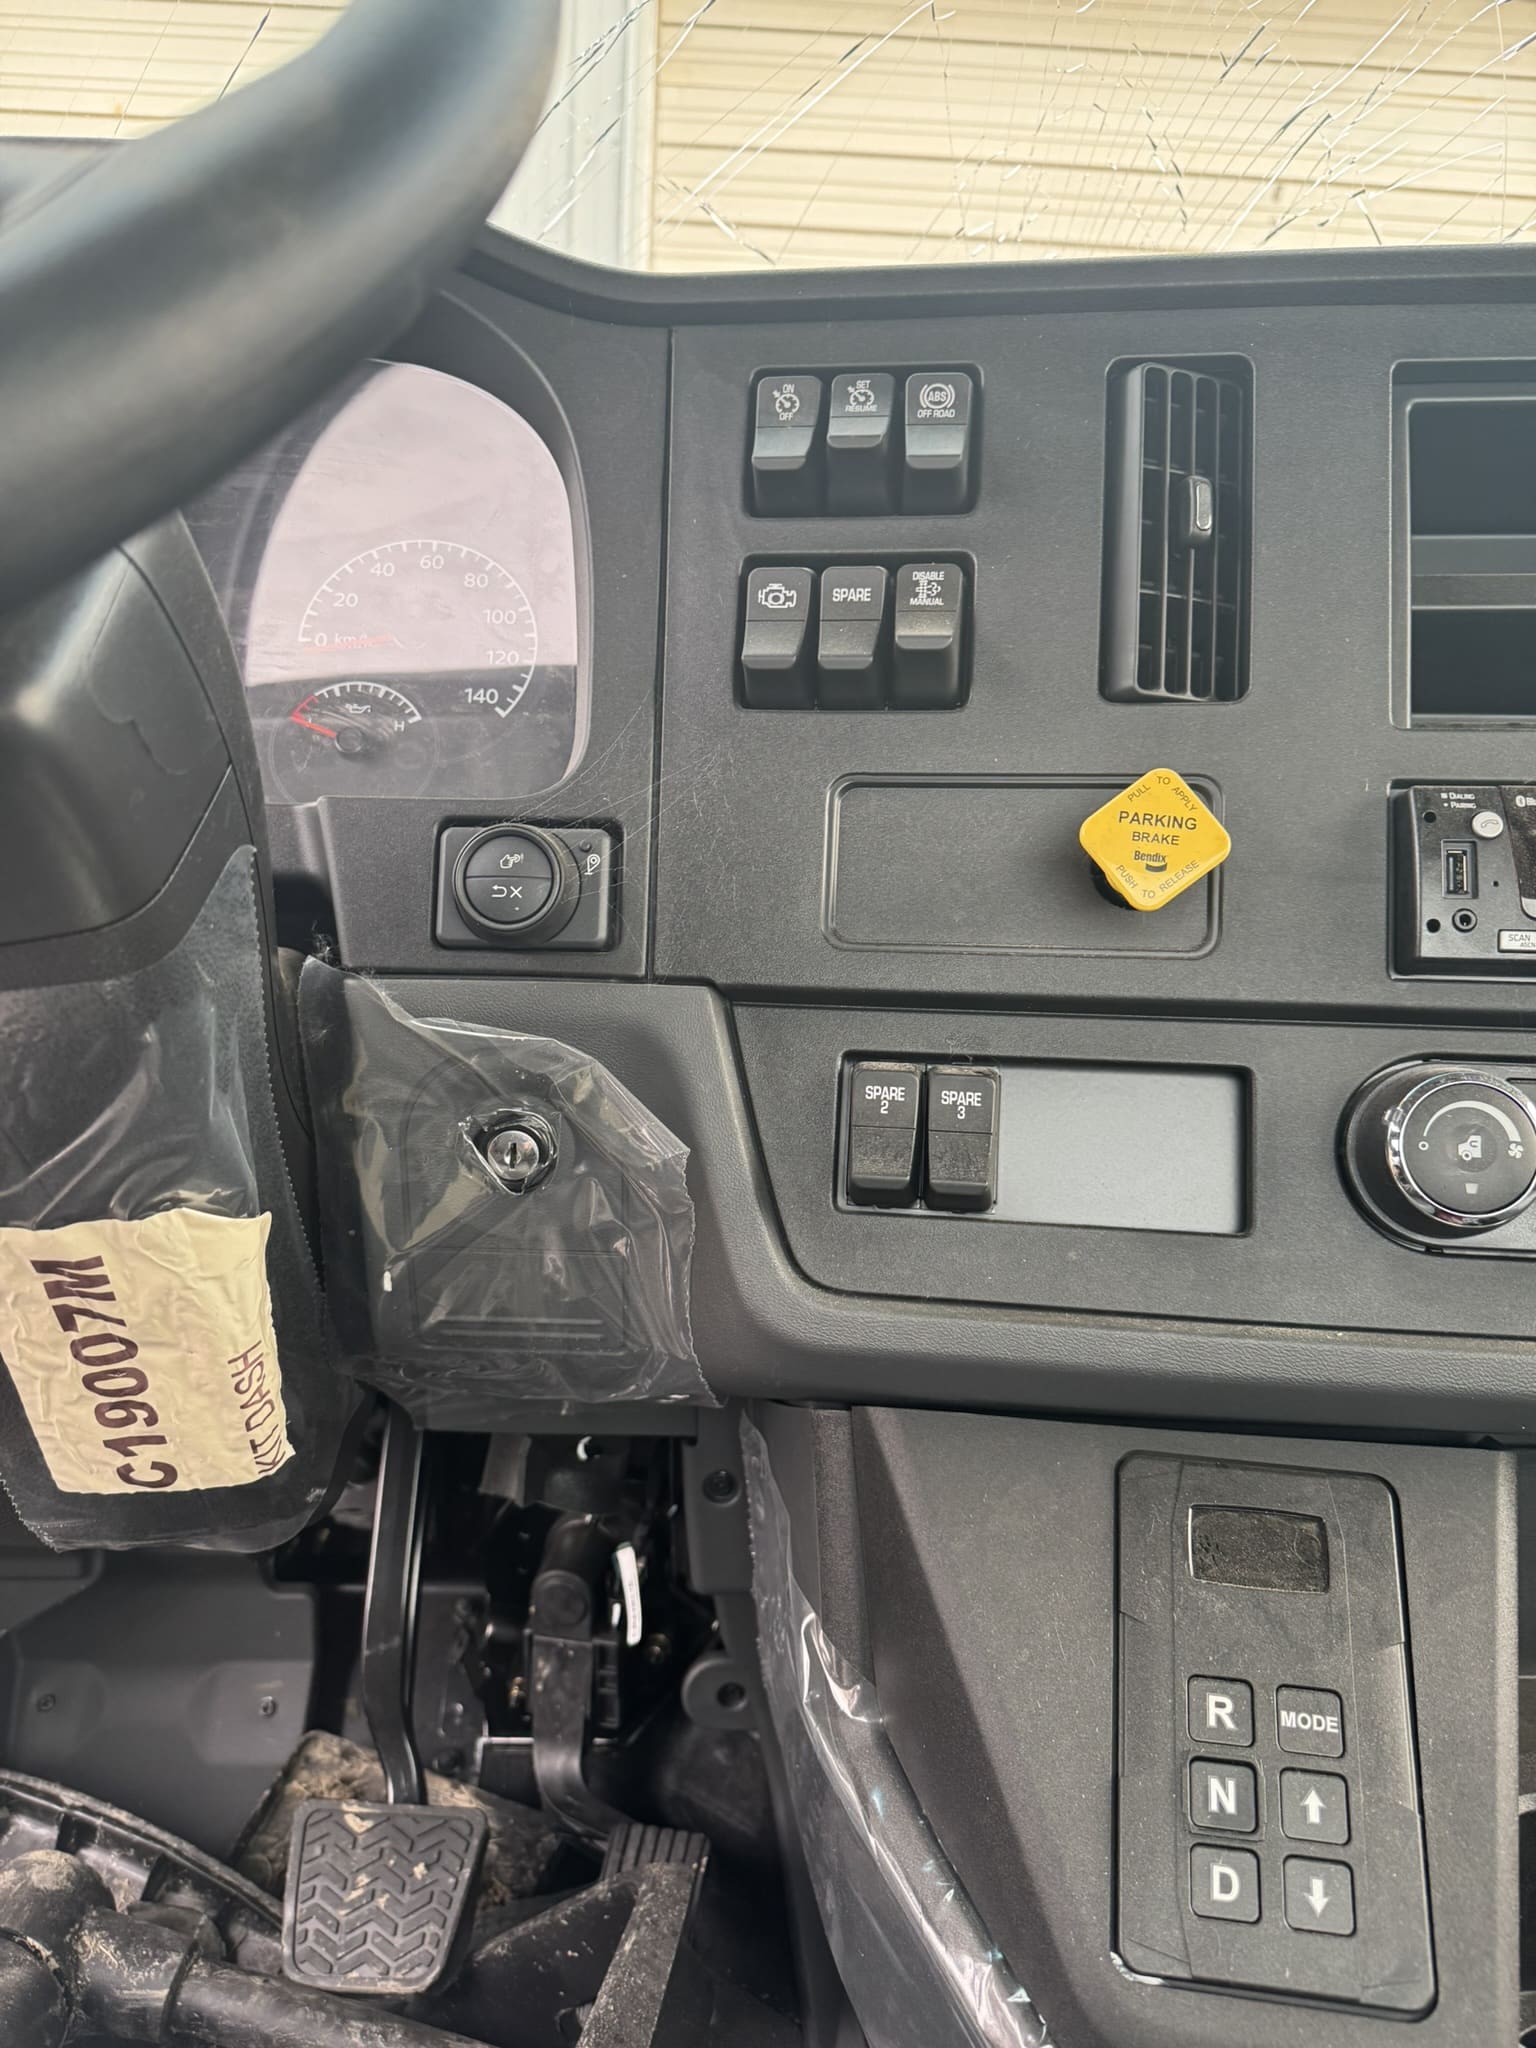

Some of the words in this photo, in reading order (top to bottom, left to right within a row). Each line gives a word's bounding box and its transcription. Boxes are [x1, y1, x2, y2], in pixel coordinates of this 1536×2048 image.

[782, 384, 794, 393] ON
[856, 380, 871, 389] SET
[927, 392, 947, 402] ABS
[845, 404, 878, 412] RESUME
[917, 410, 932, 418] OFF
[933, 409, 956, 418] ROAD
[779, 412, 794, 422] OFF
[420, 555, 444, 570] 60
[370, 563, 396, 577] 40
[912, 571, 944, 581] DISABLE
[464, 574, 488, 588] 80
[332, 593, 358, 608] 20
[832, 588, 872, 602] SPARE
[910, 597, 944, 606] MANUAL
[484, 610, 516, 624] 100
[314, 633, 327, 647] 0
[487, 651, 520, 666] 120
[464, 688, 498, 704] 140
[394, 720, 405, 732] H
[1127, 784, 1152, 803] PULL
[1156, 775, 1172, 786] TO
[1171, 786, 1199, 812] APPLY
[1118, 810, 1198, 831] PARKING
[1132, 831, 1180, 846] BRAKE
[1133, 850, 1168, 864] Bendix
[1116, 864, 1138, 888] PUSH
[1141, 889, 1156, 900] TO
[1158, 860, 1200, 892] RELEASE
[1508, 934, 1531, 942] SCAN
[865, 1086, 906, 1101] SPARE
[941, 1090, 982, 1106] SPARE
[880, 1100, 889, 1114] 2
[957, 1106, 966, 1120] 3
[30, 1255, 178, 1489] C19007M
[227, 1339, 276, 1433] DASH
[249, 1424, 286, 1475] KIT
[1206, 1693, 1238, 1730] R
[1280, 1711, 1339, 1734] MODE
[1208, 1776, 1238, 1815] N
[1210, 1863, 1240, 1903] D
